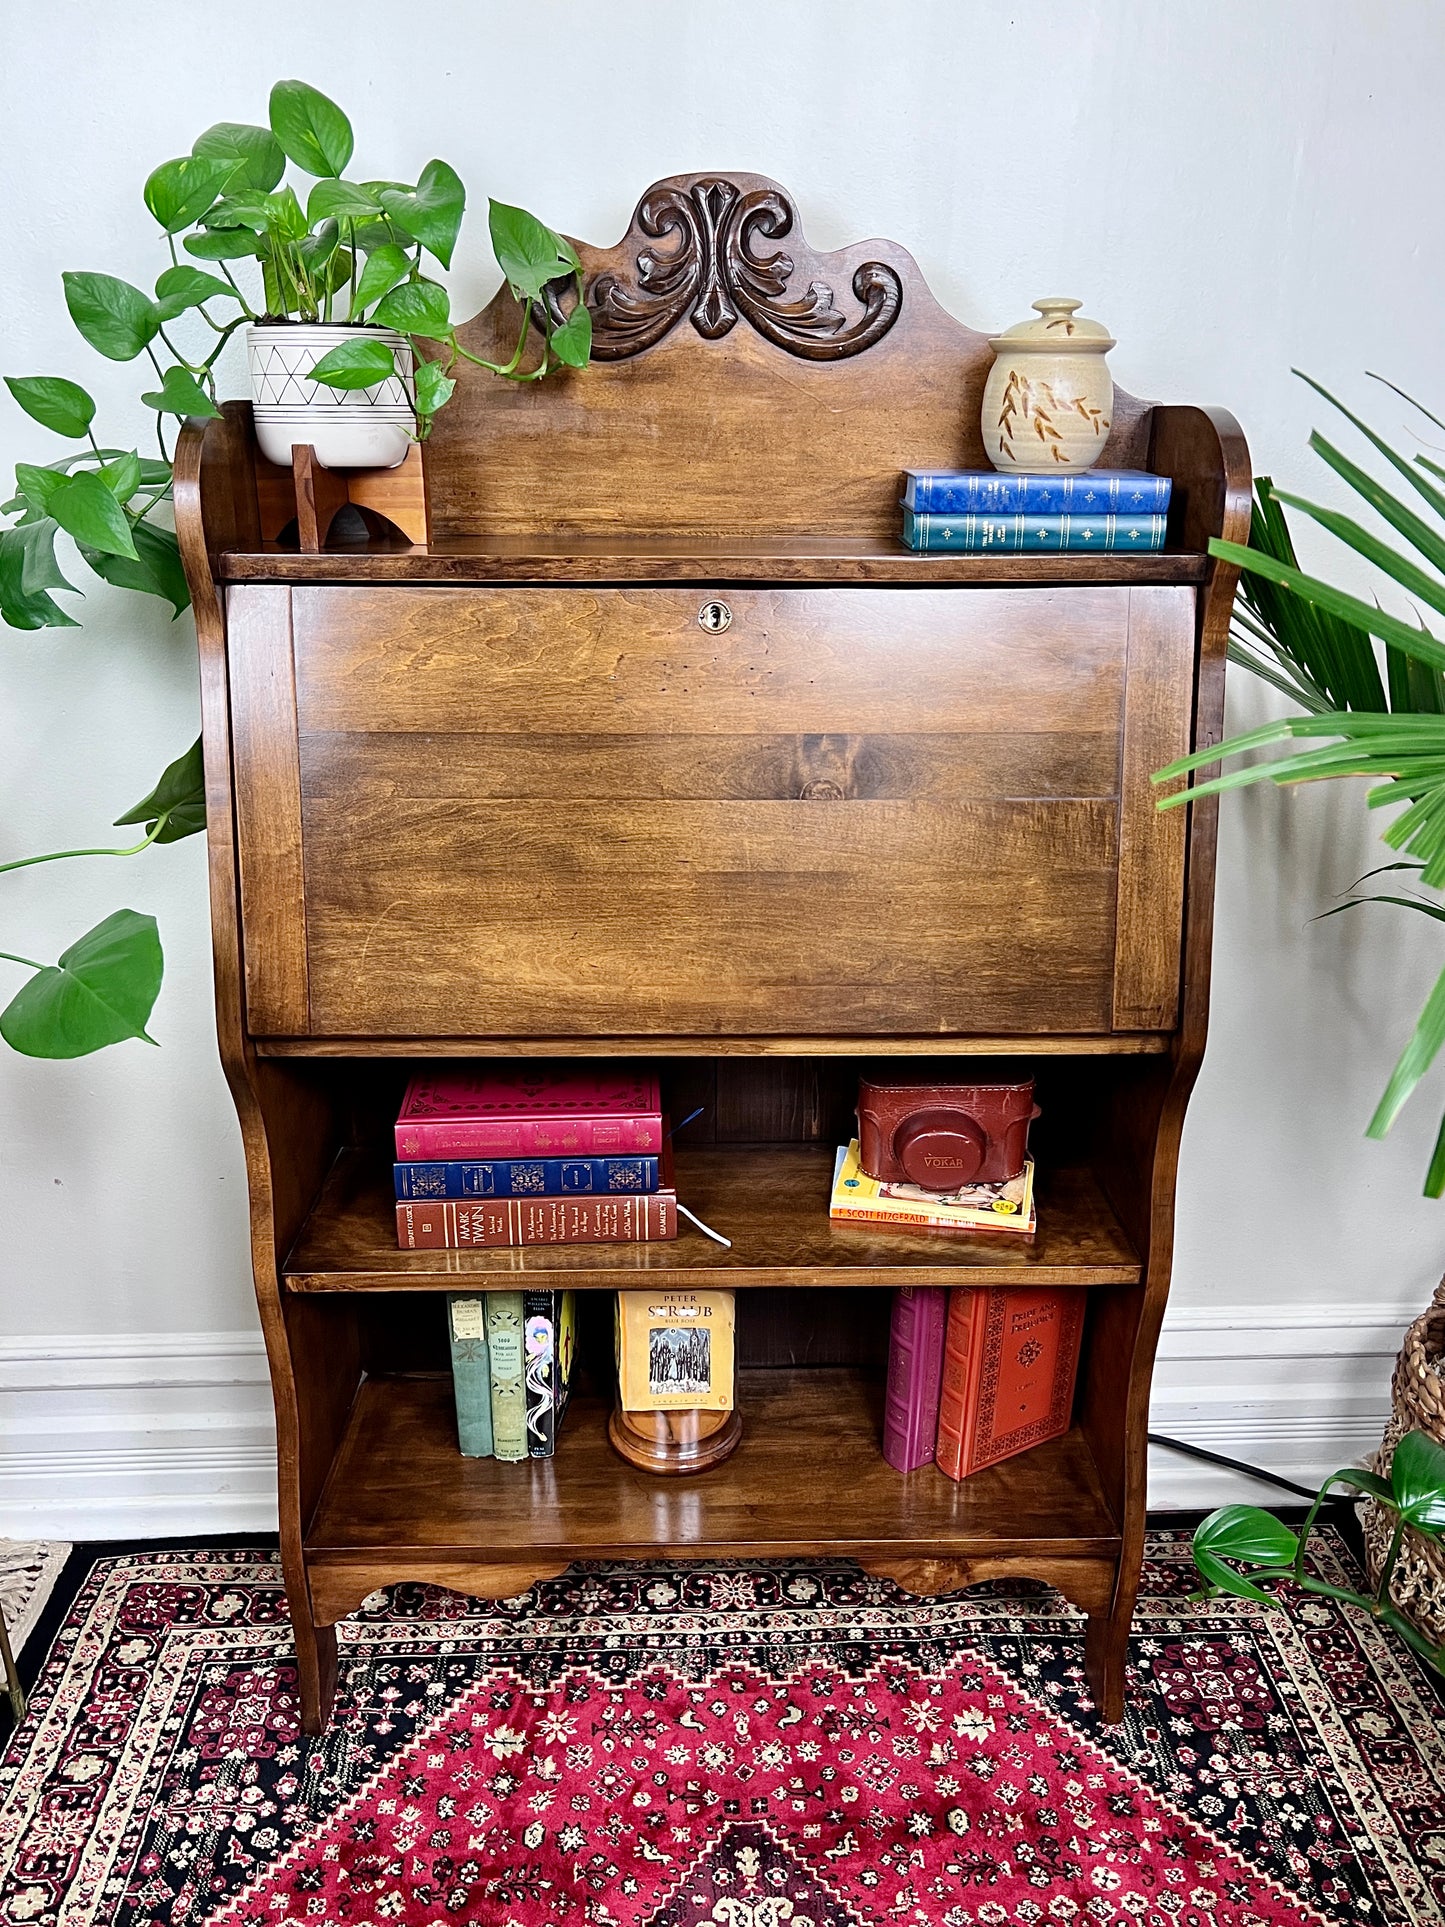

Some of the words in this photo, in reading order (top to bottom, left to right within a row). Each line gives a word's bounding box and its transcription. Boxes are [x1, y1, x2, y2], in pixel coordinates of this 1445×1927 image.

[924, 1157, 963, 1169] VOKAR
[406, 1205, 414, 1229] CLASSICS
[459, 1211, 471, 1240] MARK
[471, 1206, 485, 1244] TWAIN
[488, 1216, 496, 1235] Selected
[659, 1203, 667, 1235] GRAMERCY
[838, 1208, 846, 1217] F.
[846, 1209, 874, 1219] SCOTT
[876, 1211, 926, 1223] FITZGERALD
[1011, 1312, 1054, 1335] PREJUDICE
[1012, 1308, 1036, 1323] PRIDE
